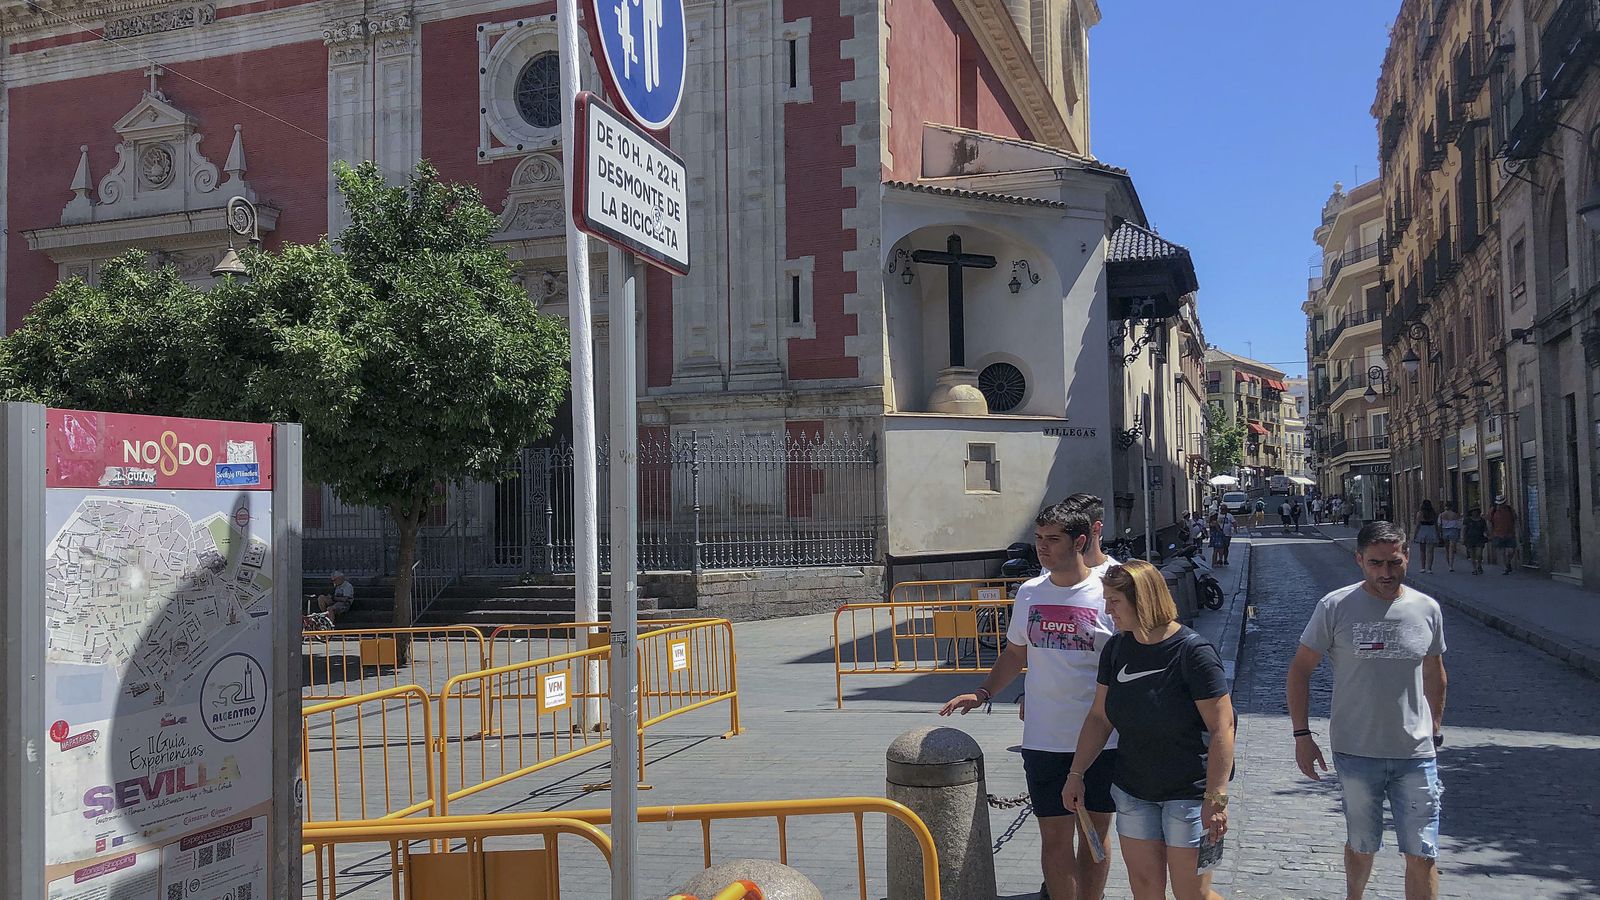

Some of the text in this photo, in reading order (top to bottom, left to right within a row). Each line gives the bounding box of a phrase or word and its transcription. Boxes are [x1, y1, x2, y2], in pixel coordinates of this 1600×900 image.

[597, 119, 613, 150] DE
[646, 153, 654, 176] A
[598, 154, 681, 222] DESMONTE DE
[601, 191, 617, 220] LA
[1044, 428, 1096, 437] VILLEGAS
[674, 648, 684, 658] VFM
[548, 680, 563, 693] VFM
[212, 705, 257, 723] ALCENTRO
[129, 743, 204, 777] Experiencias
